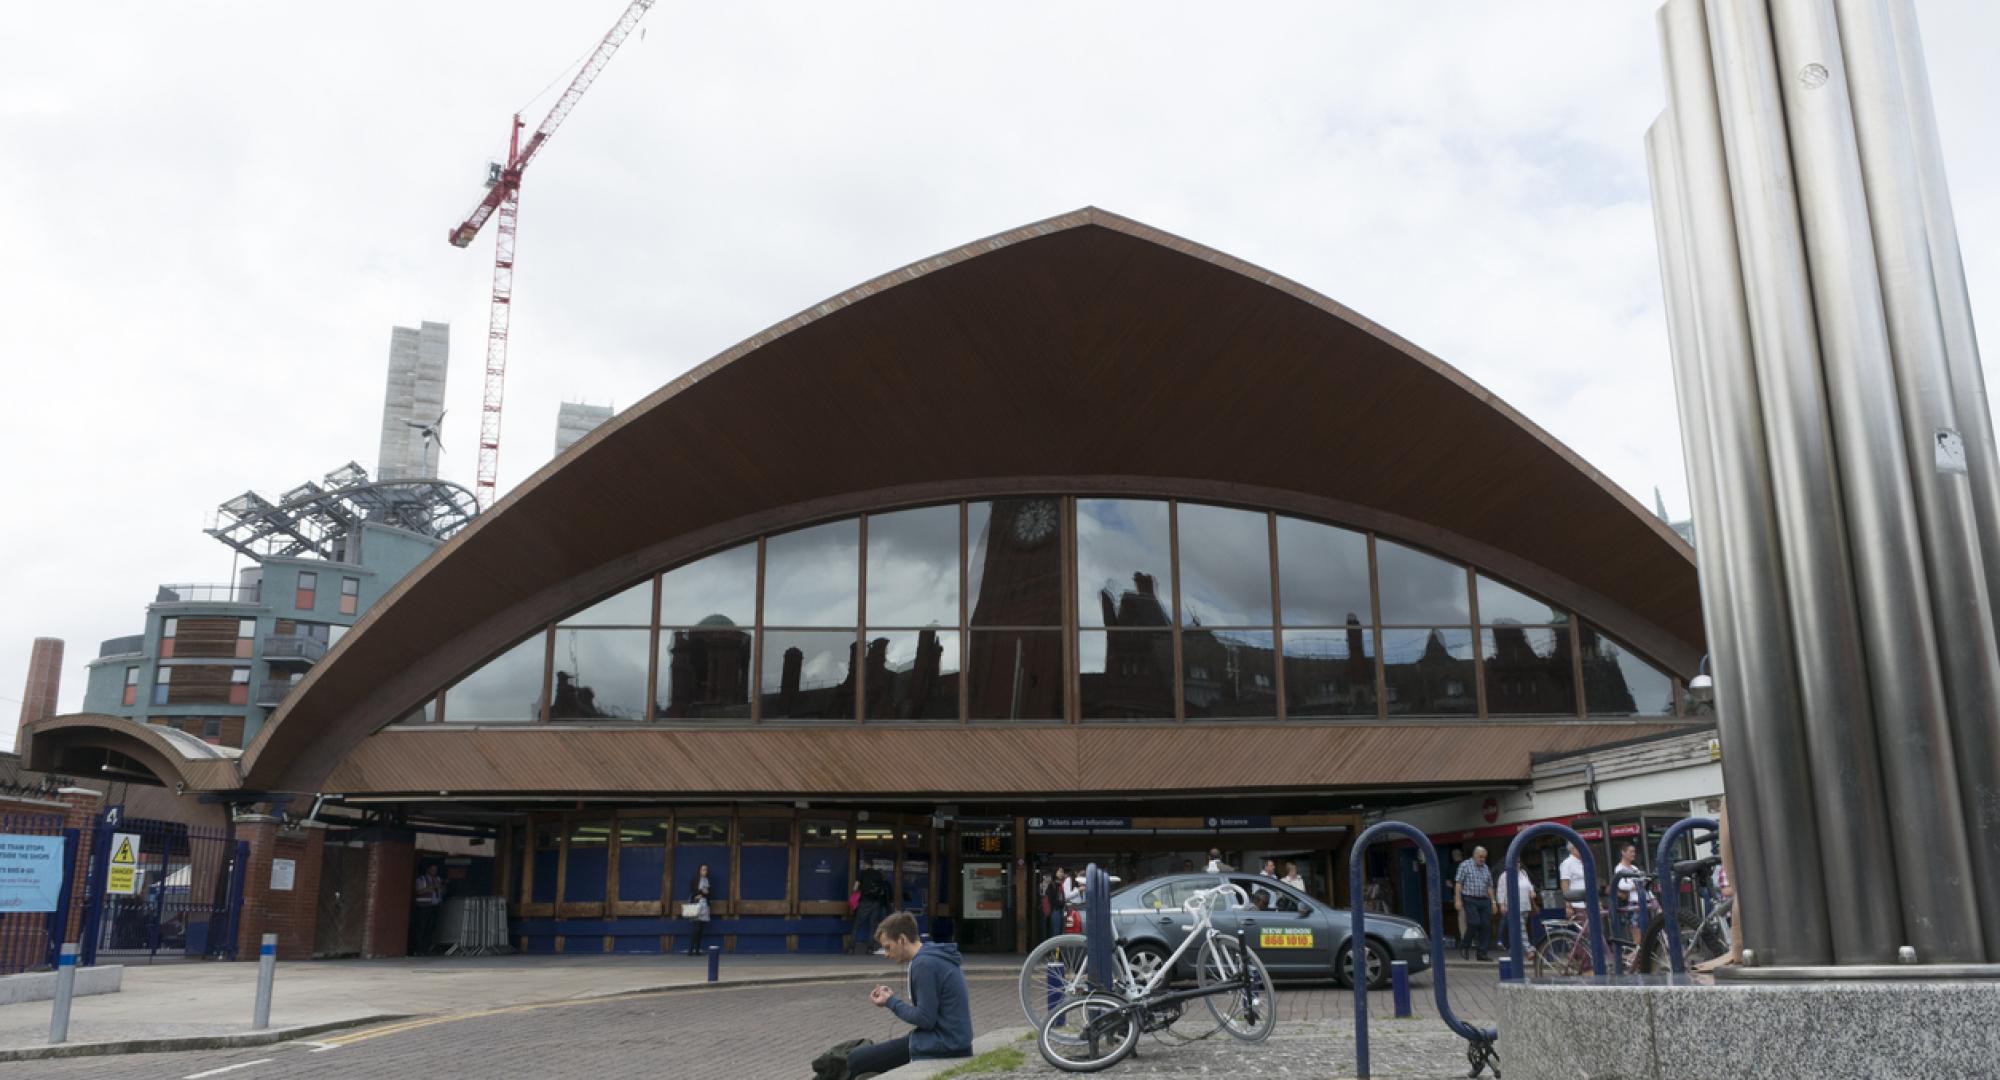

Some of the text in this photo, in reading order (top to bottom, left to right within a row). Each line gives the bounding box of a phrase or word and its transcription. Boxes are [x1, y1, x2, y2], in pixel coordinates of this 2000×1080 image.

[106, 808, 118, 826] 4
[1262, 927, 1311, 935] NEW MOON
